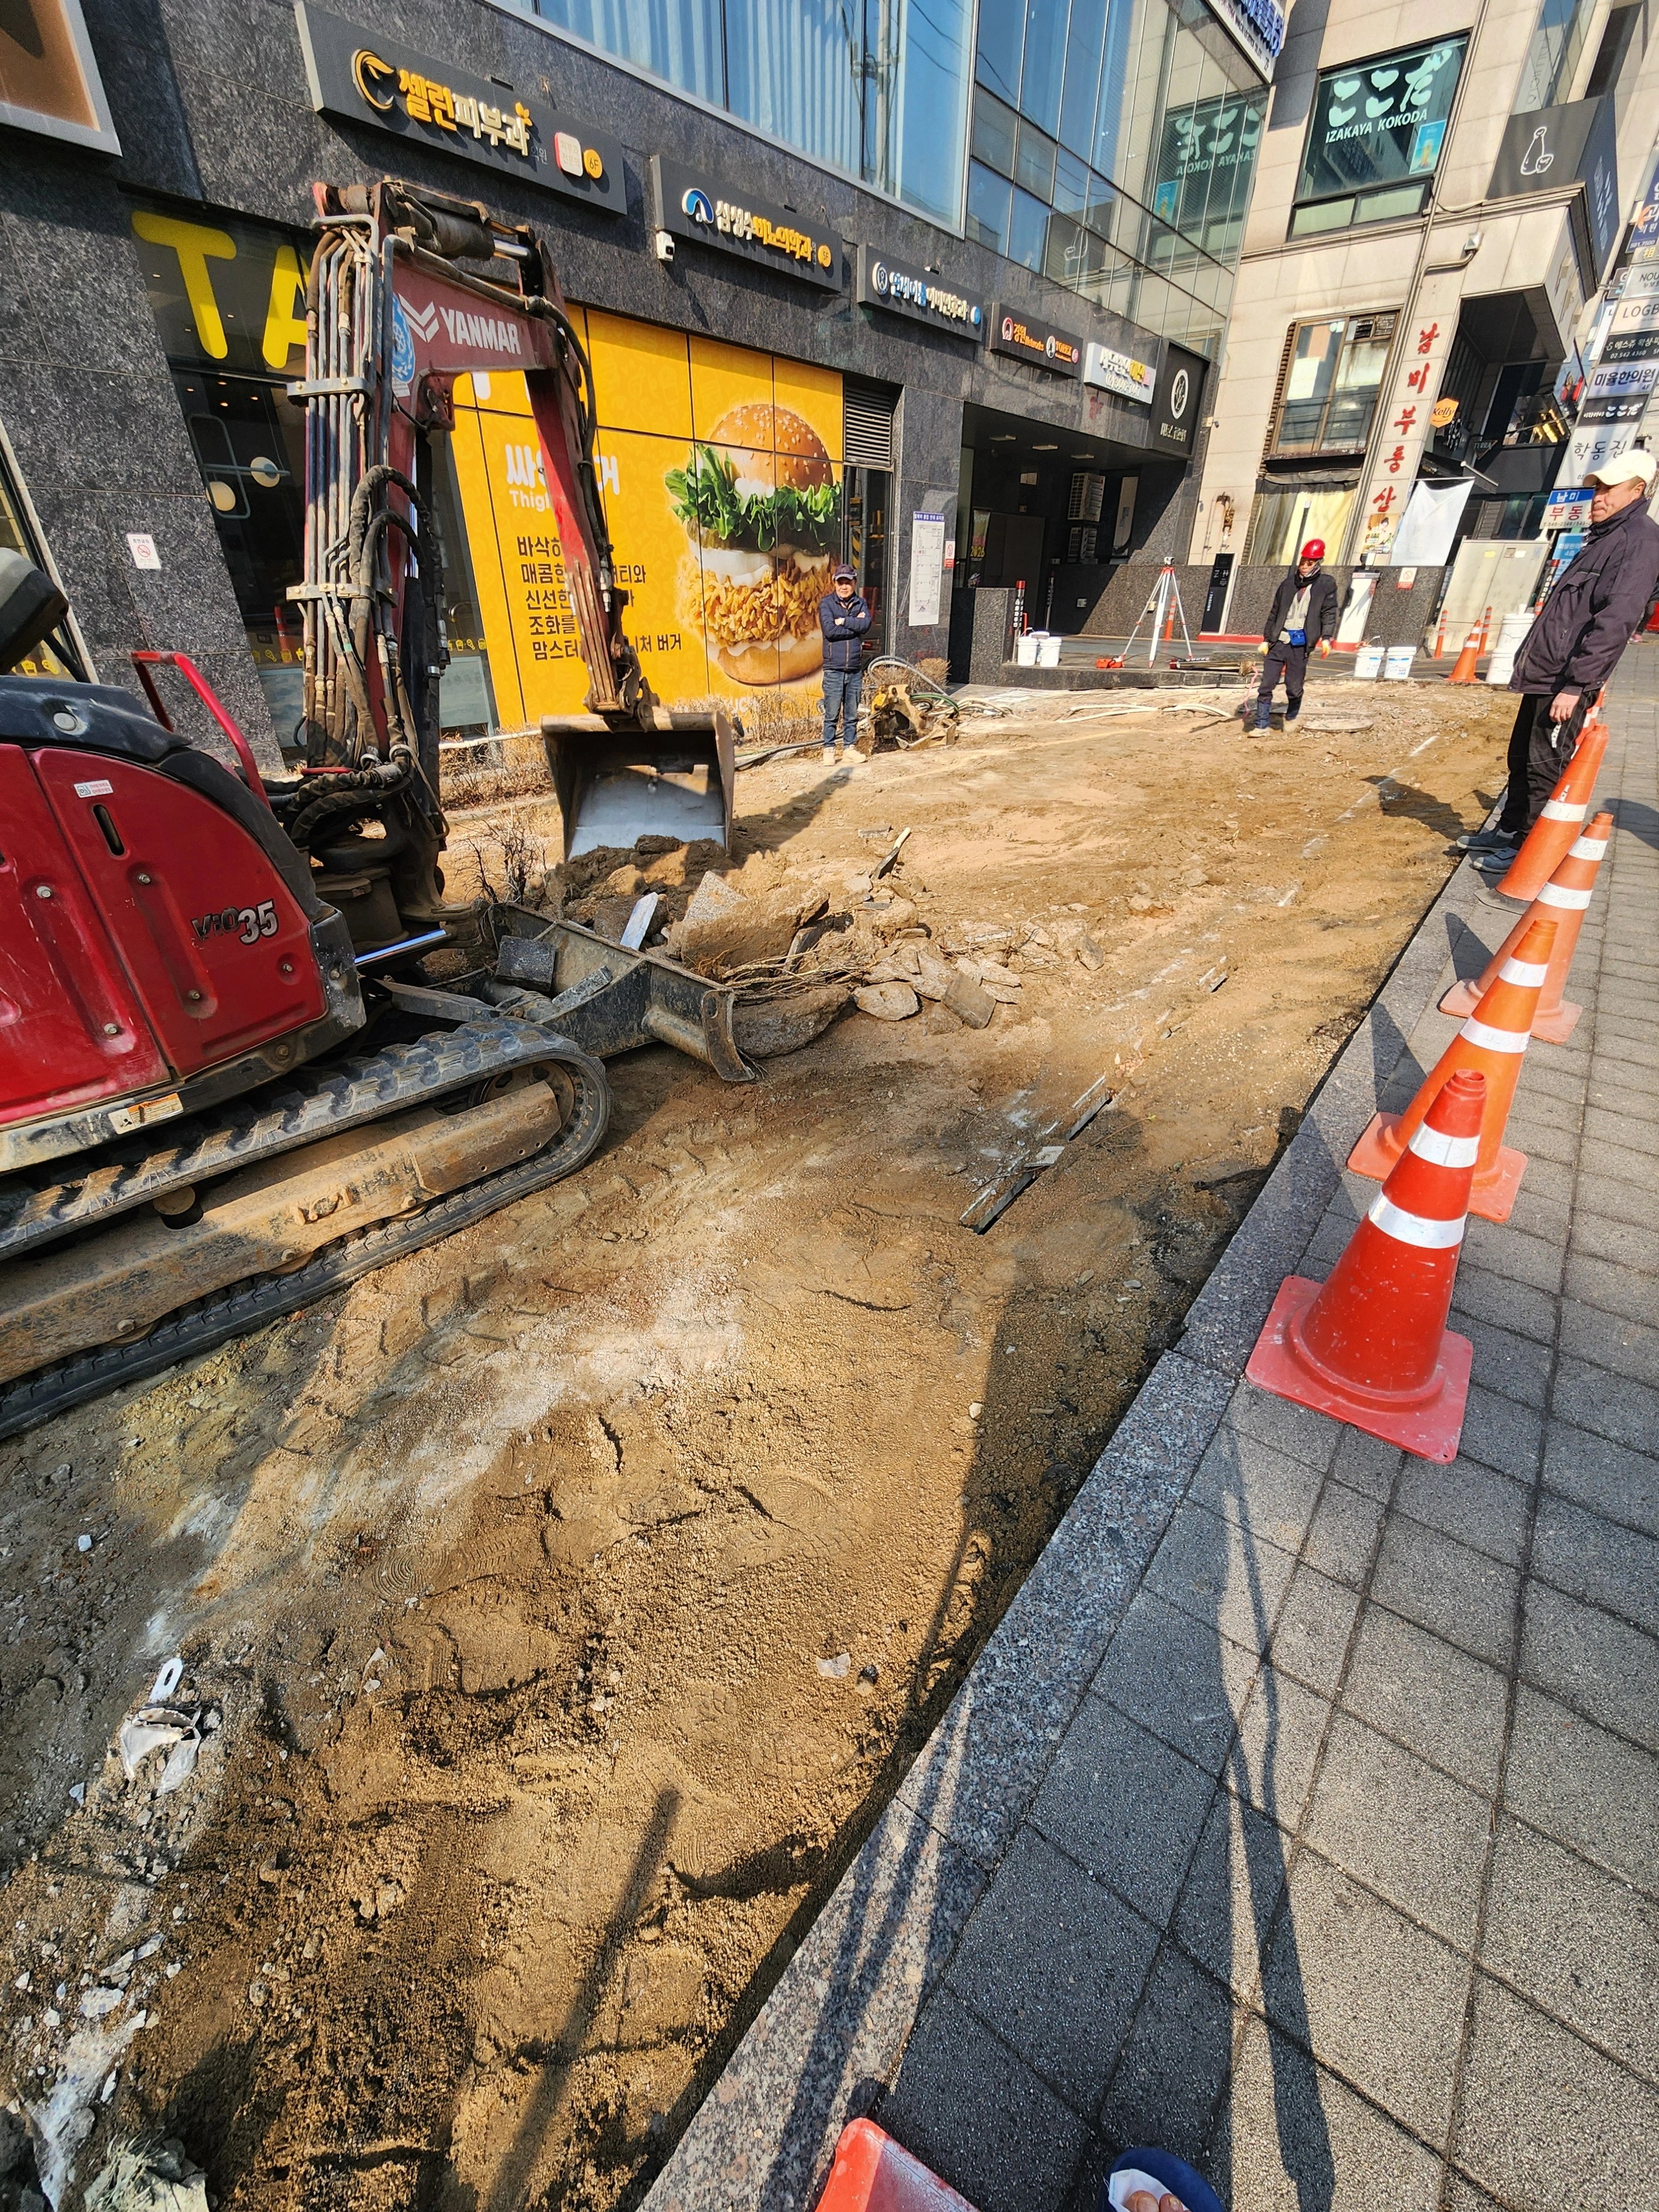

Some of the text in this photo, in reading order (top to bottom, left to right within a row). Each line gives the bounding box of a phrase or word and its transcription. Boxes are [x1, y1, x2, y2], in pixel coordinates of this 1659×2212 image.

[1329, 49, 1452, 128] ここだ
[399, 69, 529, 158] 셀린피부과
[1326, 108, 1427, 144] IZAKAYA KOKODA
[589, 158, 598, 170] 6F
[823, 251, 829, 261] 5F
[439, 306, 521, 355] YANMAR
[1594, 368, 1656, 387] 미율한의원
[1433, 406, 1455, 418] Kelly
[1556, 491, 1580, 503] 남미
[970, 545, 985, 558] 2026
[529, 615, 576, 635] 조화를
[657, 633, 681, 651] 버거
